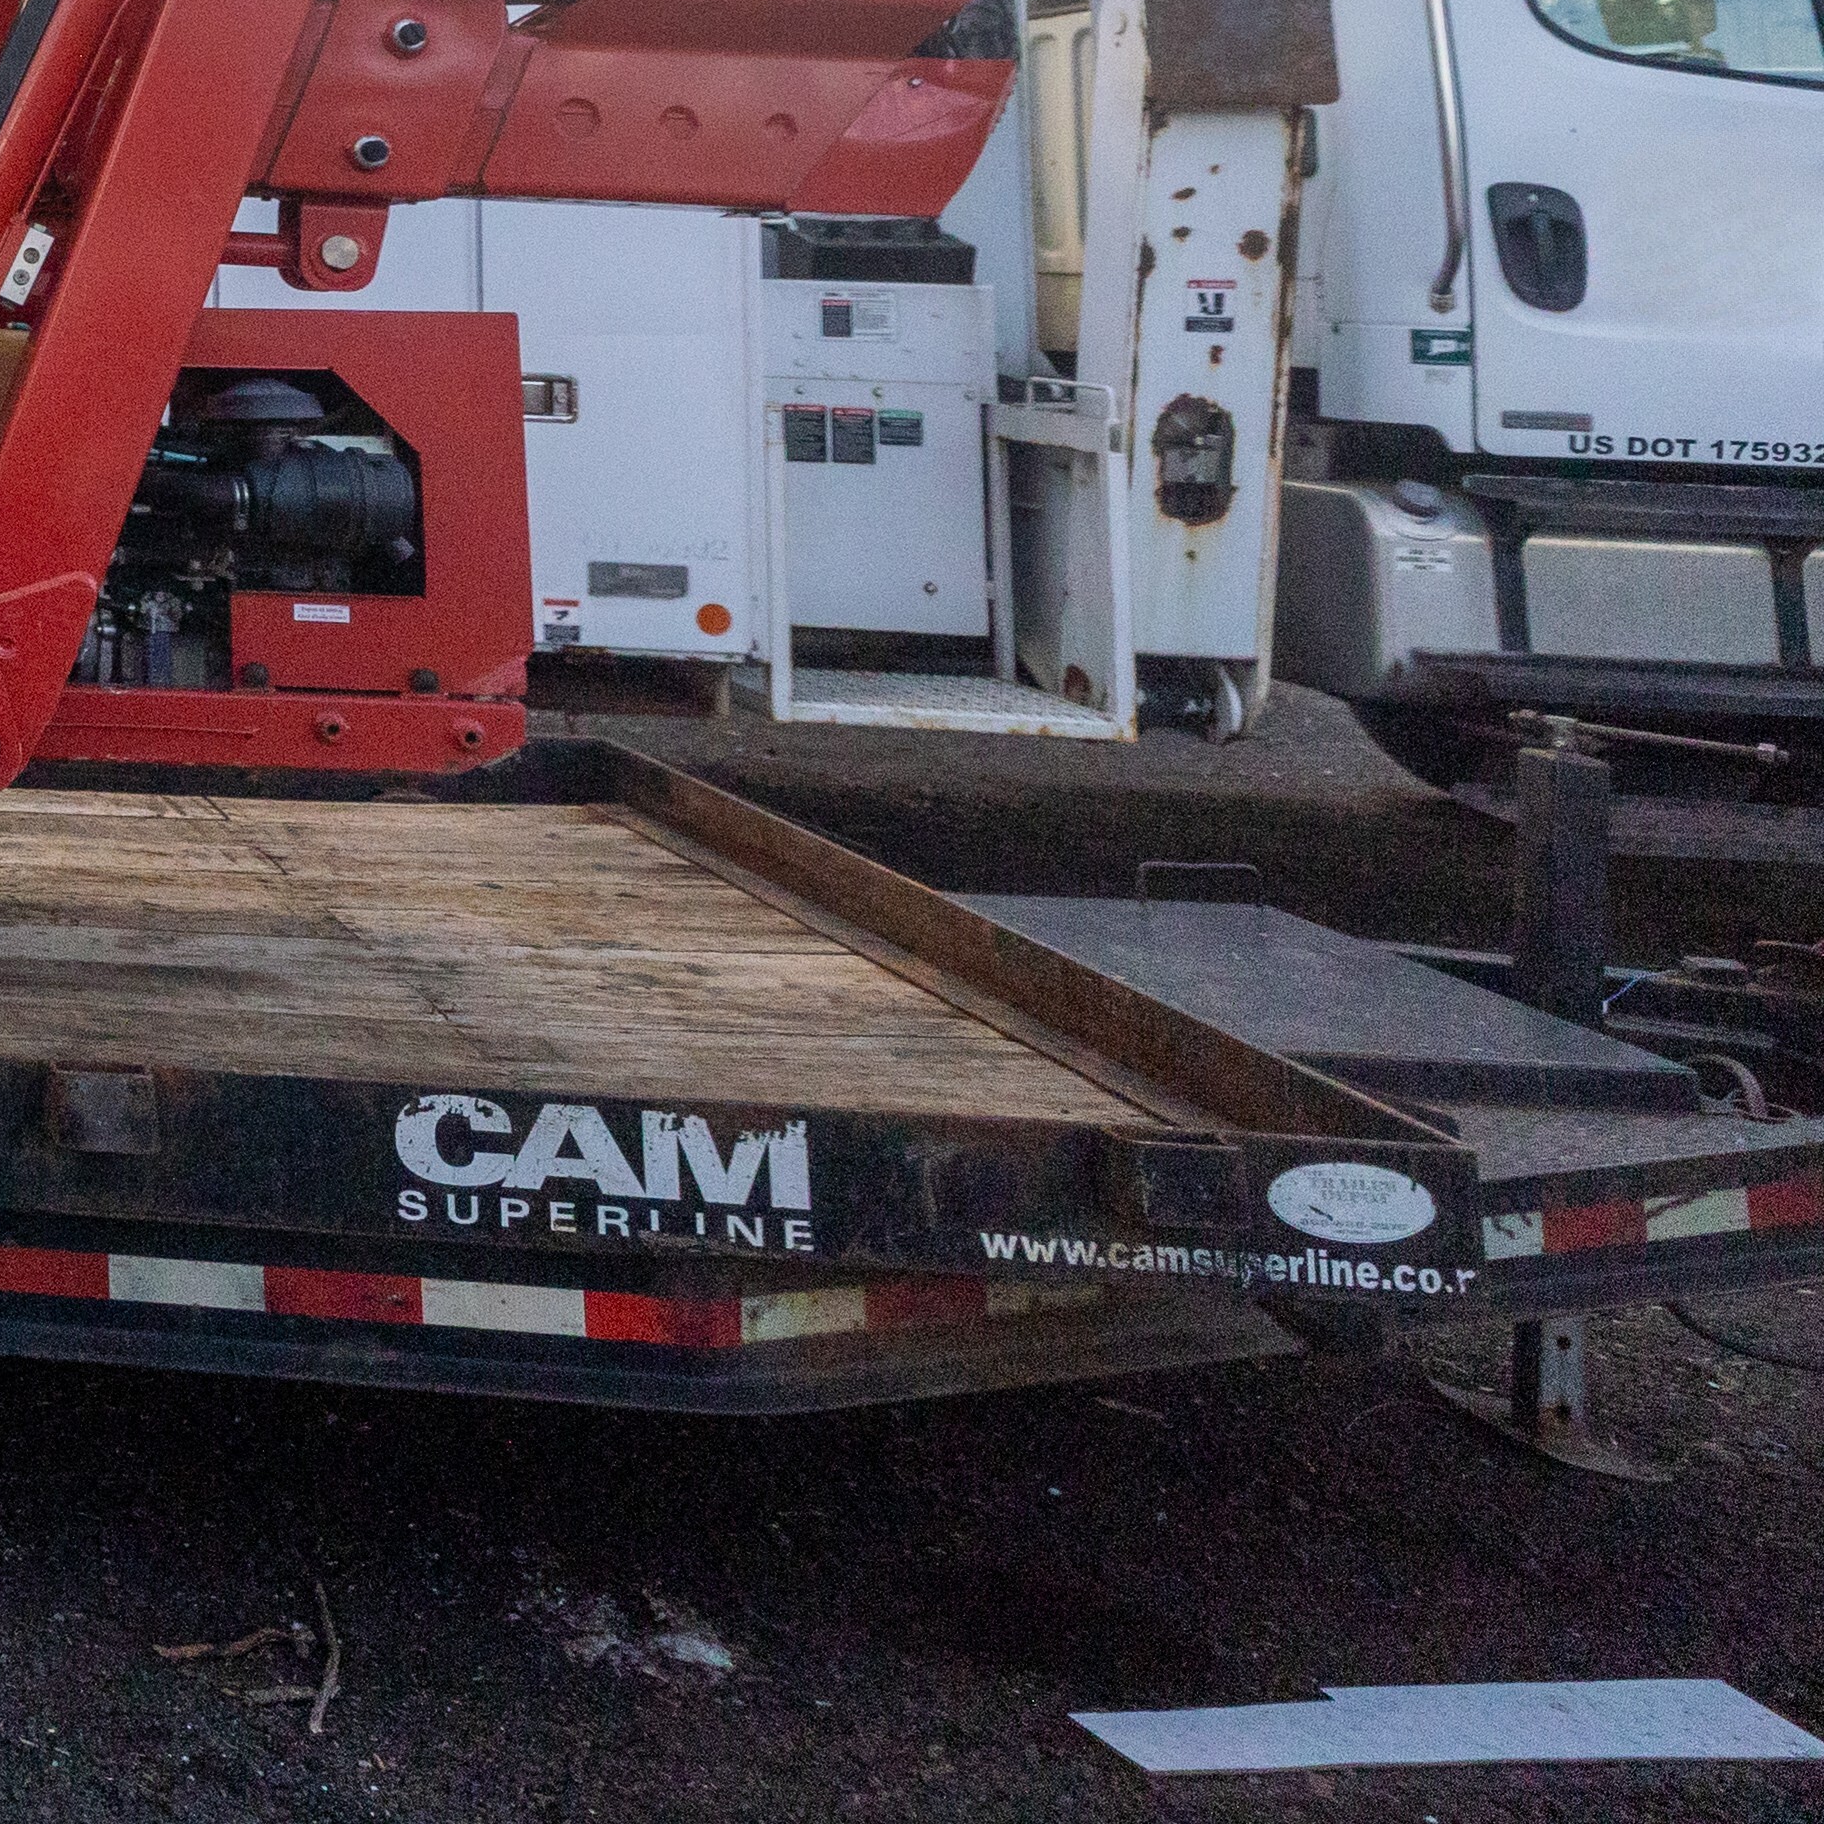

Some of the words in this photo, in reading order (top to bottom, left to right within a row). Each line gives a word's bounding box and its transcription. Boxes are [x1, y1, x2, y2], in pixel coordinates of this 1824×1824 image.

[1568, 434, 1614, 455] US
[1627, 436, 1696, 458] DOT
[395, 1094, 812, 1210] CAM
